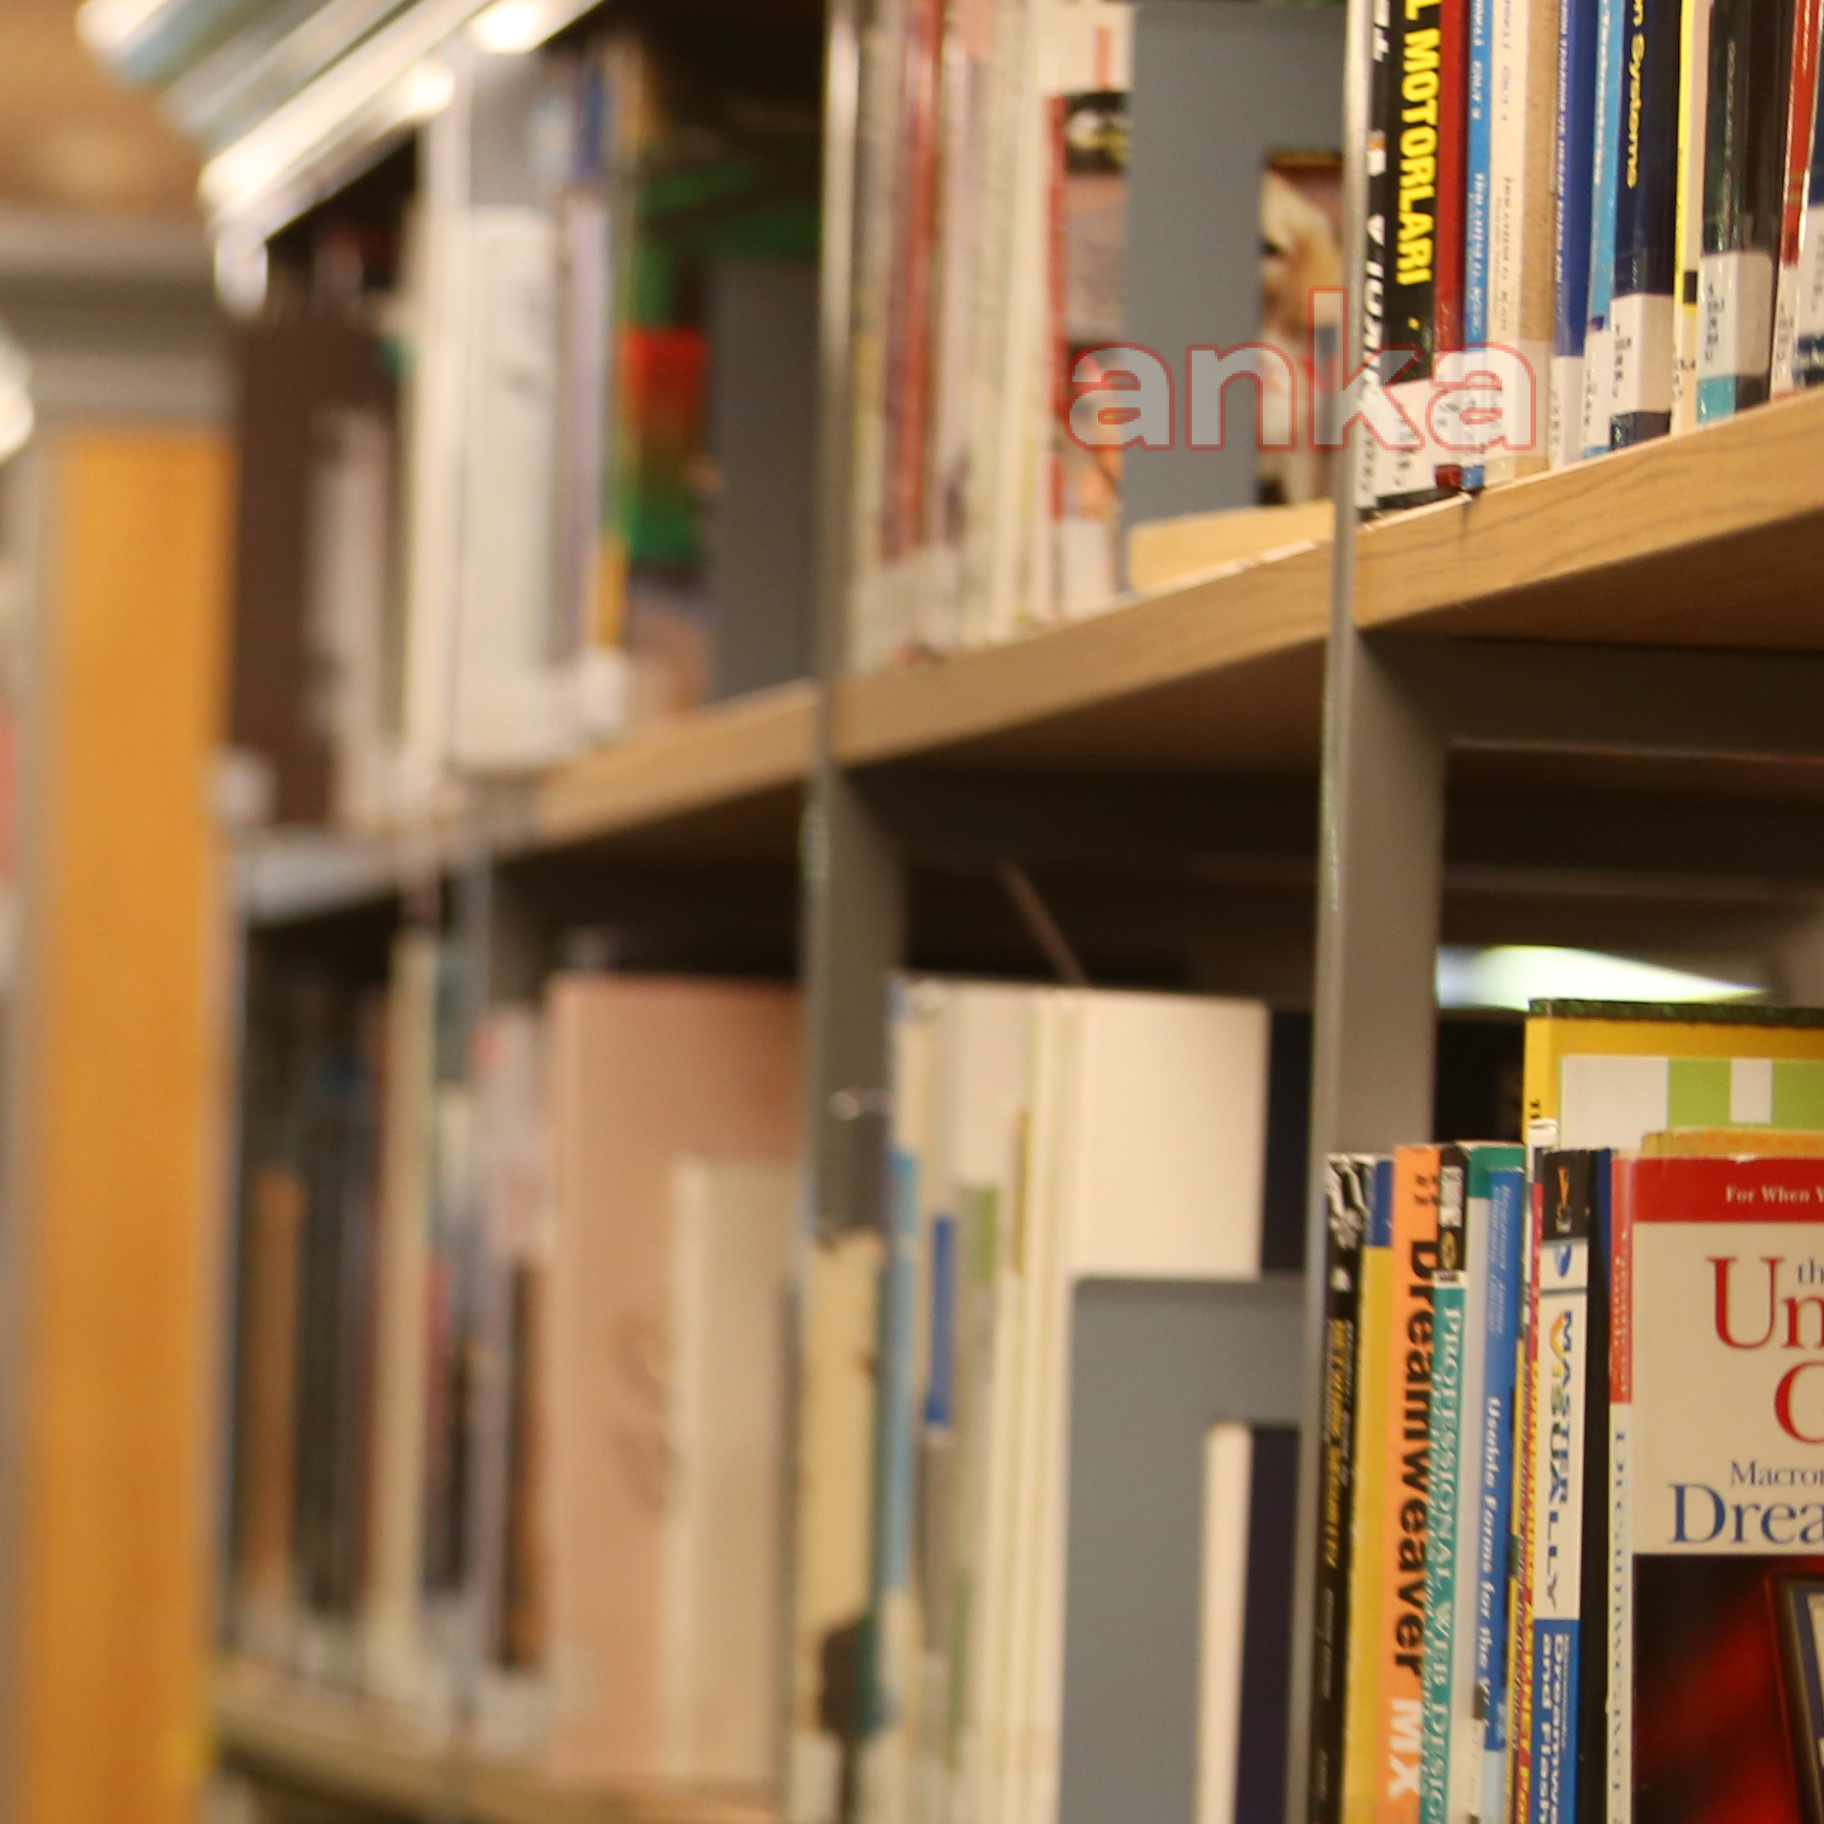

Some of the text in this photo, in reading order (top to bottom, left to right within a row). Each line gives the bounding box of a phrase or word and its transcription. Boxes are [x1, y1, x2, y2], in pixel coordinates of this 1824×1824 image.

[1397, 28, 1442, 285] MOTORLARI
[1625, 33, 1647, 189] Systems
[1725, 1184, 1811, 1204] For When
[1705, 1255, 1824, 1350] Un
[1435, 1307, 1465, 1590] PROFESSIONAL
[1484, 1396, 1502, 1488] Usable
[1557, 1309, 1573, 1504] MASTER
[1547, 1311, 1565, 1609] VISUALLY
[1388, 1240, 1440, 1798] Dreamweaver MX
[1480, 1494, 1500, 1574] Forms
[1432, 1600, 1452, 1687] WEB
[1476, 1626, 1494, 1669] the
[1479, 1580, 1496, 1620] for
[1541, 1632, 1553, 1710] and
[1538, 1721, 1552, 1824] Flash
